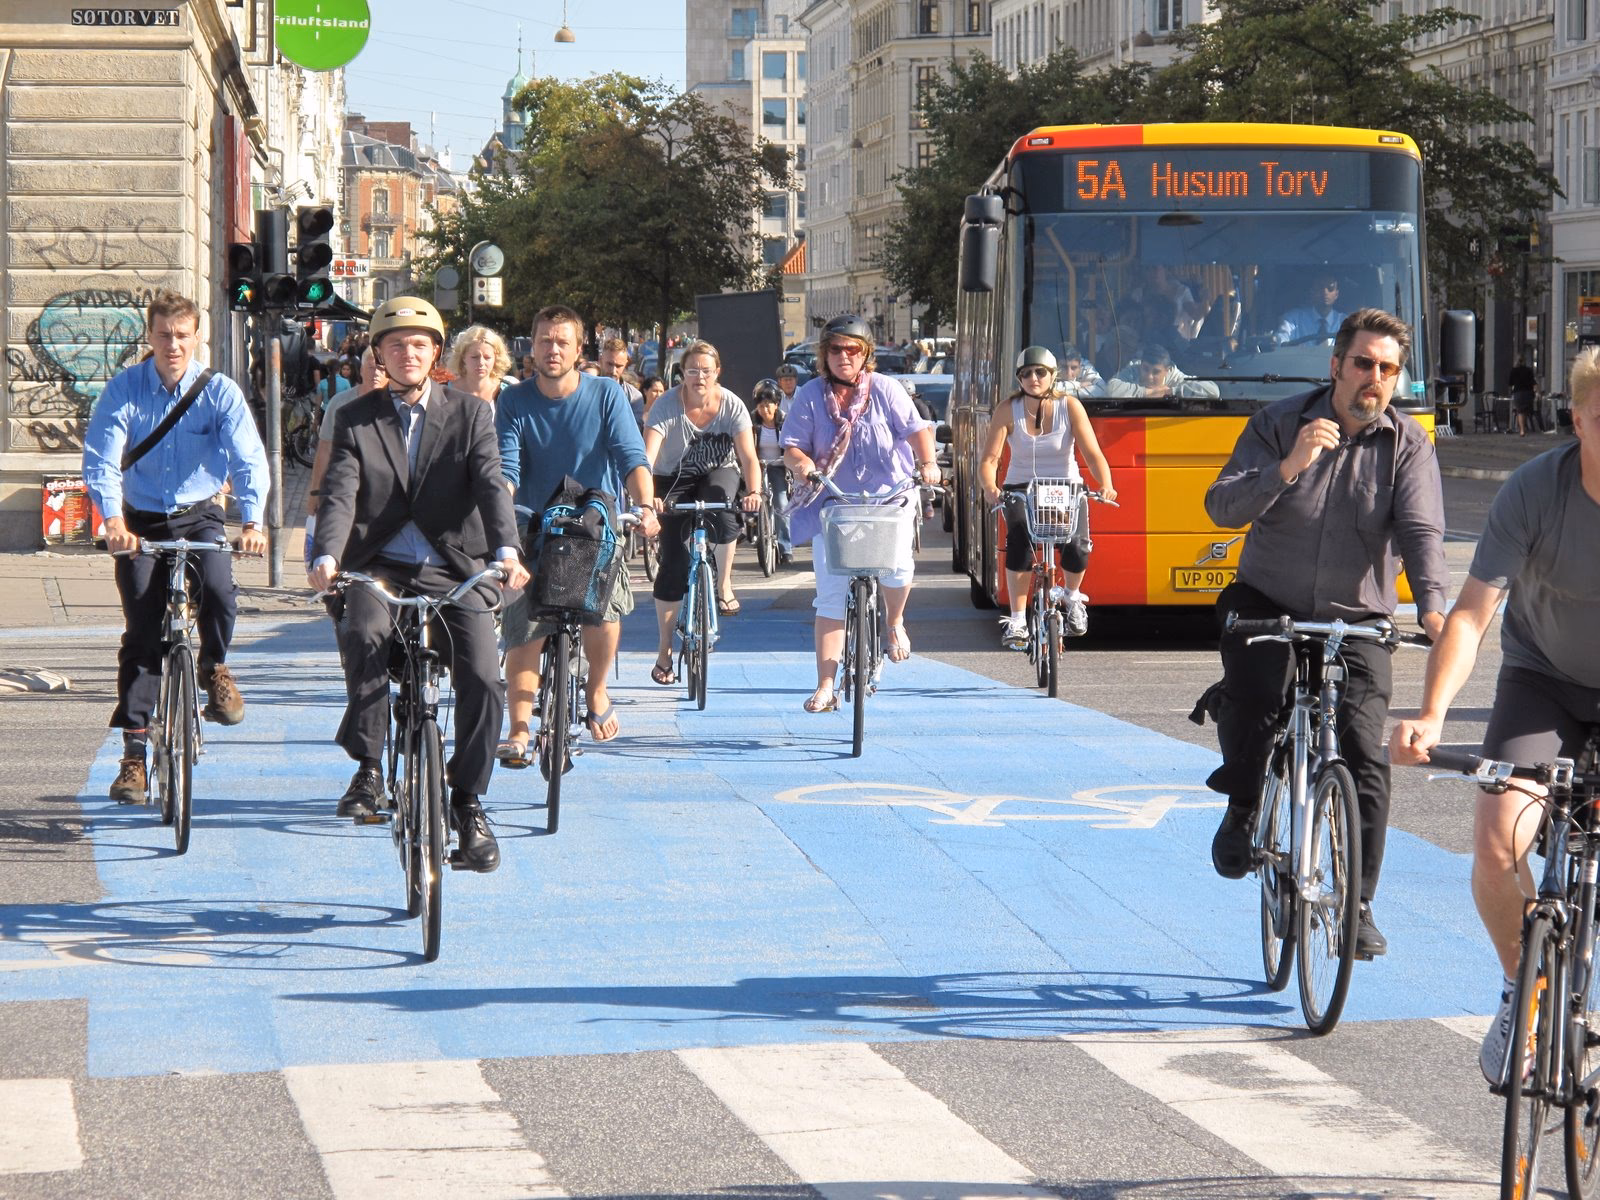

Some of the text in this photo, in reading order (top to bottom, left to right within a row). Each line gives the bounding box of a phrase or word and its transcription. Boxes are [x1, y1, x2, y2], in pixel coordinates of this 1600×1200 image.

[72, 10, 178, 25] SØTORVET
[1077, 160, 1328, 200] 5A Husum Torv
[328, 263, 367, 272] lektronik
[46, 480, 85, 491] globa
[1044, 496, 1064, 504] CPH
[1182, 572, 1201, 586] VP
[1206, 572, 1223, 586] 90
